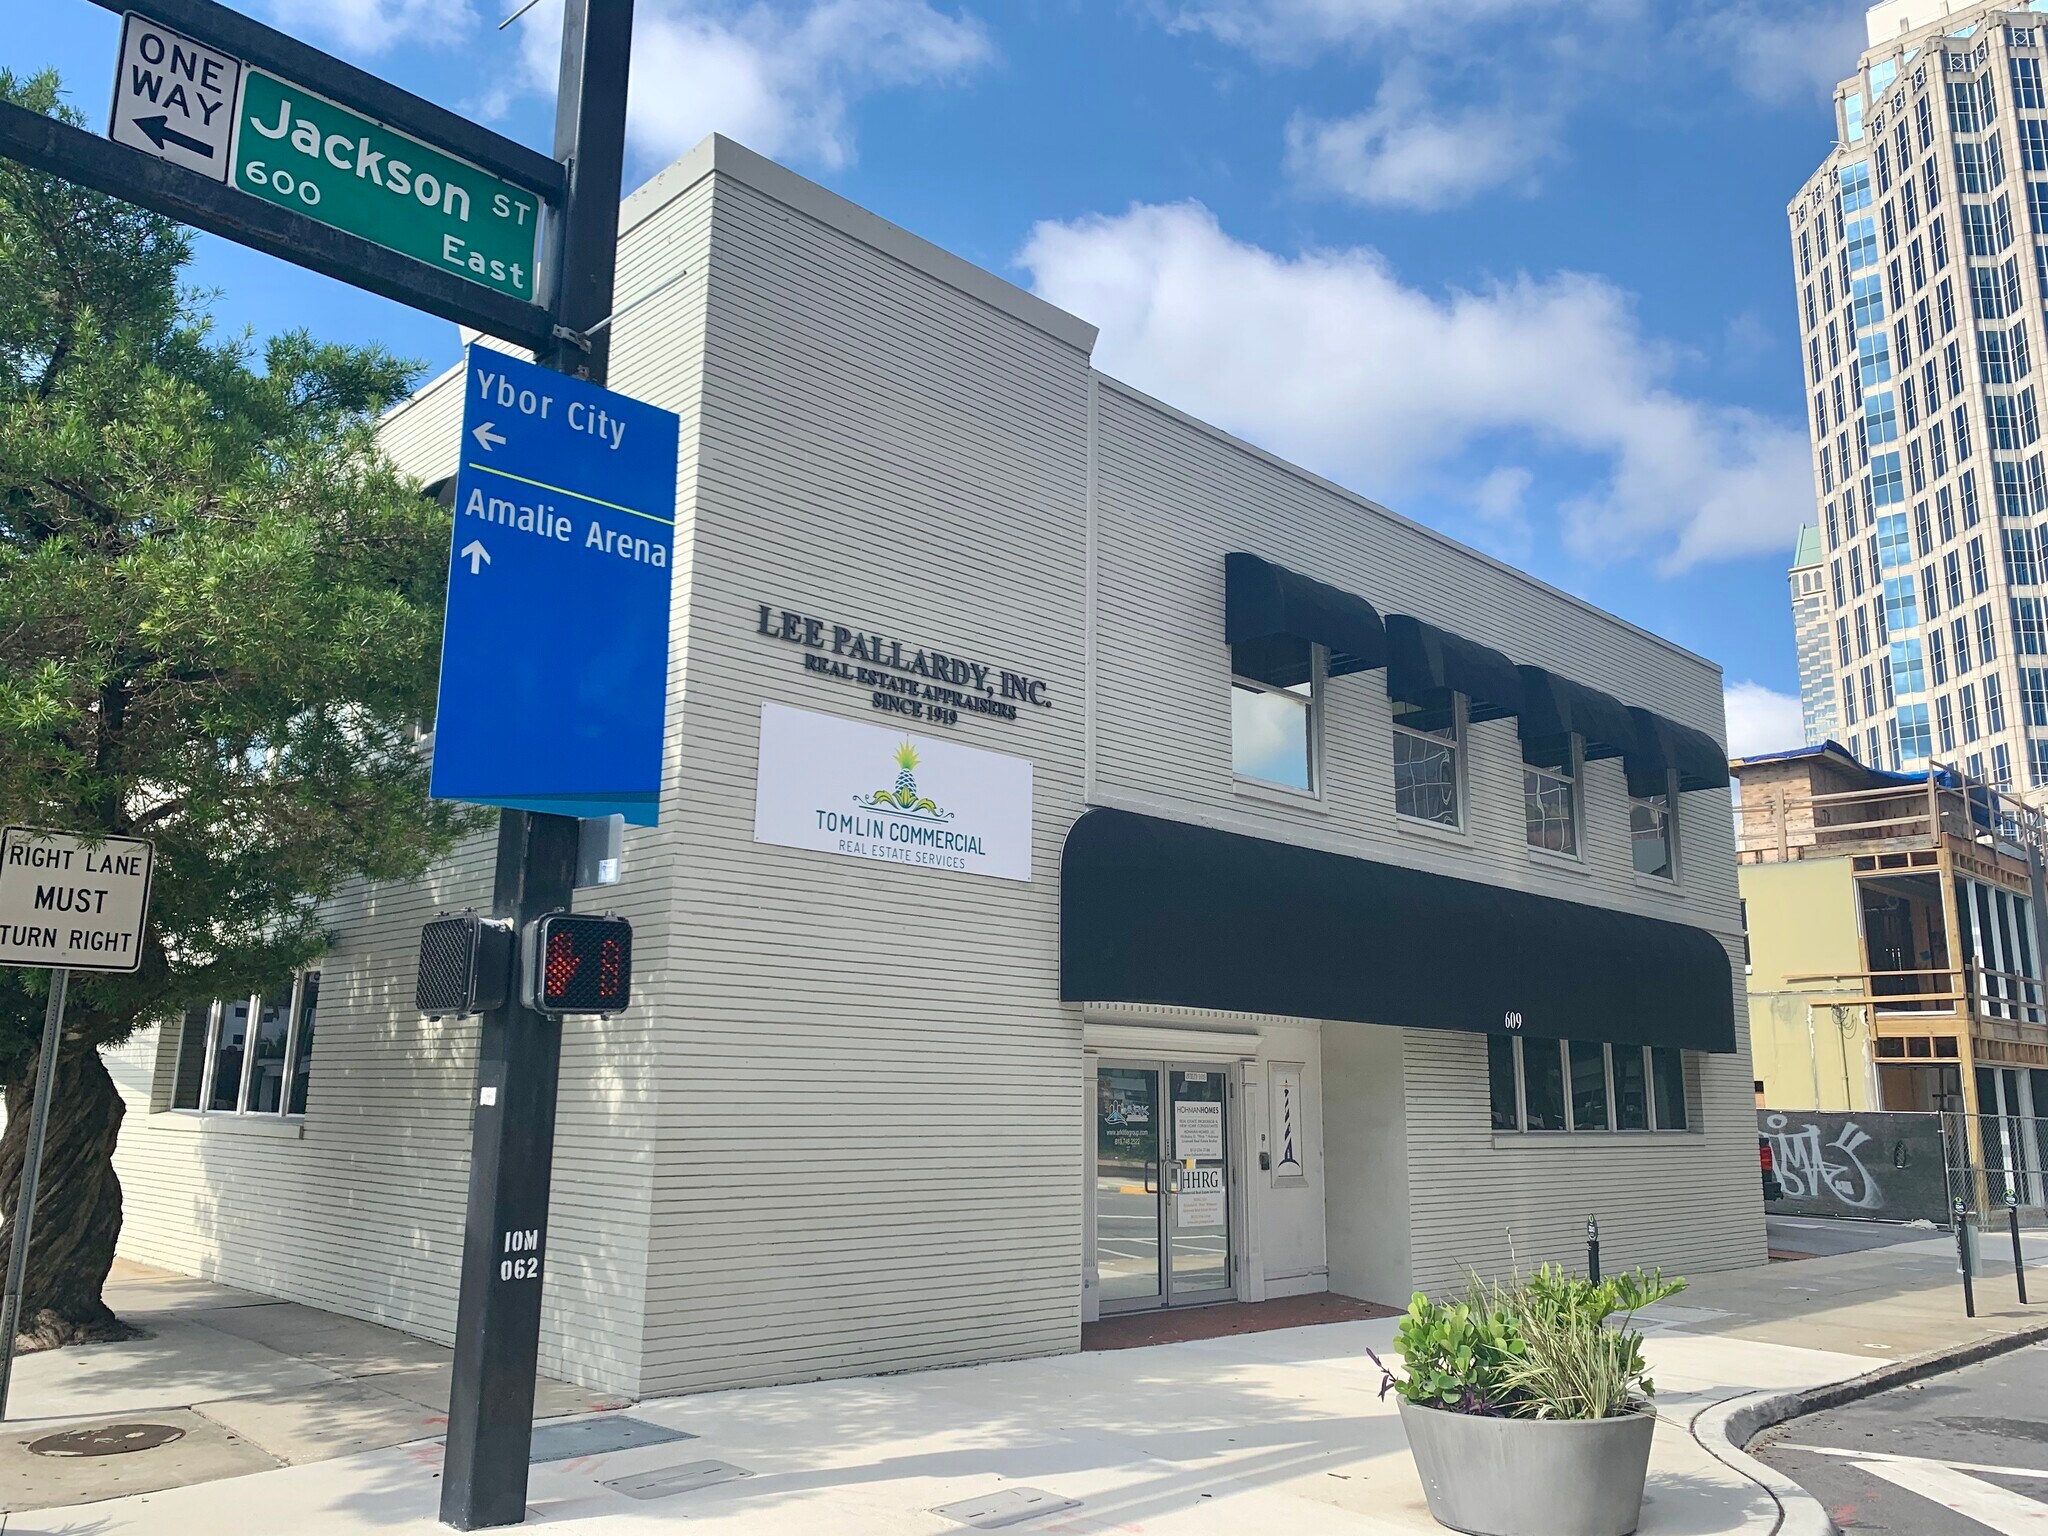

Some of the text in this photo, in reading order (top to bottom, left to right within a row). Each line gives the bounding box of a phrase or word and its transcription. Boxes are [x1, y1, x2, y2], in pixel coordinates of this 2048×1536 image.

[139, 33, 225, 94] ONE
[132, 65, 224, 127] WAY
[244, 161, 321, 206] 600
[250, 99, 531, 226] Jackson ST
[442, 234, 524, 289] East
[477, 368, 626, 450] Ybor City
[465, 488, 667, 568] Amalie Arena
[756, 604, 1053, 708] LEE PALLARDY, INC.
[803, 652, 1017, 721] REAL ESTATE APPRAISERS
[872, 691, 958, 726] SINCE 1919
[816, 809, 986, 856] TOMLIN COMMERCIAL
[838, 839, 966, 869] REAL ESTATE SERVICES
[9, 845, 142, 876] RIGHT LANE
[34, 885, 108, 914] MUST
[0, 924, 132, 952] TURN RIGHT
[1505, 1010, 1522, 1029] 609
[1125, 1104, 1150, 1116] ARK
[1183, 1170, 1218, 1188] HHRG
[500, 1257, 539, 1281] 062
